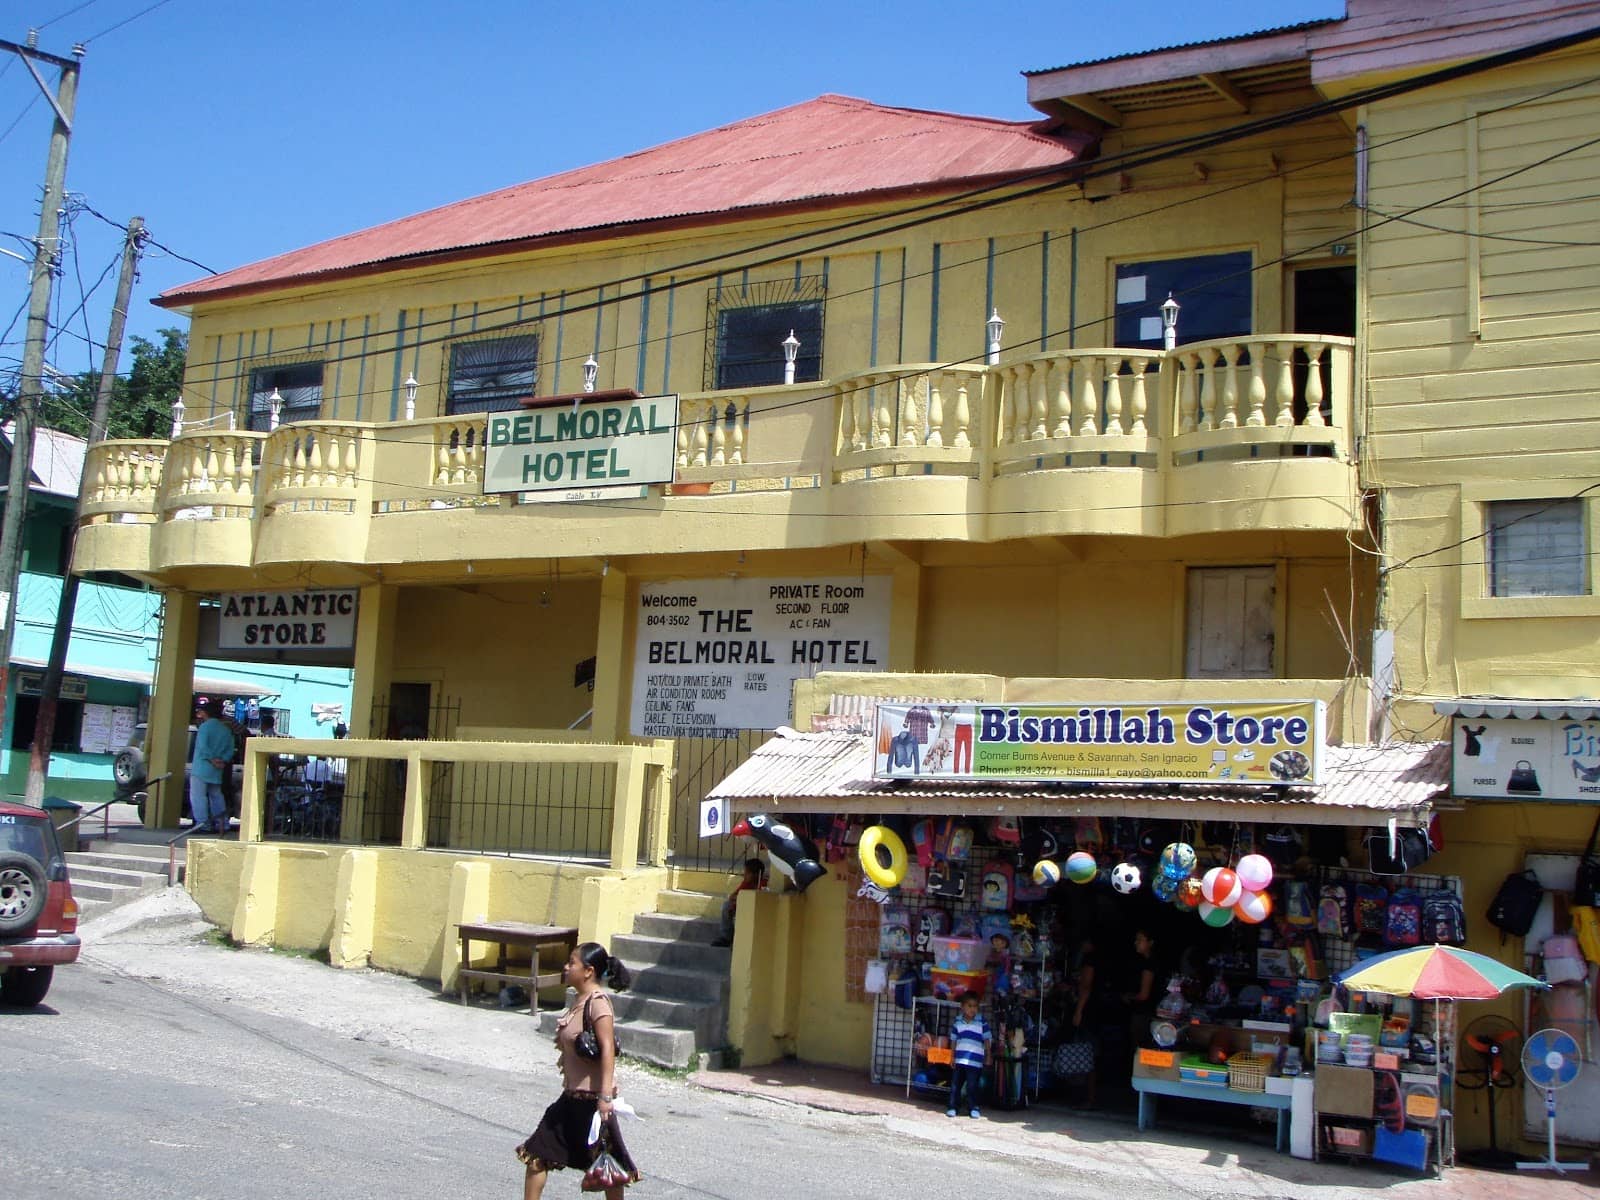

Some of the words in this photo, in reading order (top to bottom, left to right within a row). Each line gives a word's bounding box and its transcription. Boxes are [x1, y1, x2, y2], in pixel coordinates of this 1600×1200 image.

[490, 404, 670, 447] BELMORAL
[522, 447, 630, 484] HOTEL
[769, 584, 820, 599] PRIVATE
[825, 585, 864, 598] Room
[224, 594, 353, 617] ATLANTIC
[642, 594, 697, 608] Welcome
[775, 603, 811, 615] SECOND
[821, 602, 850, 614] FLOOR
[647, 615, 690, 626] 804-3502
[698, 609, 753, 632] THE
[789, 620, 803, 629] AC
[812, 619, 831, 629] FAN
[244, 622, 326, 645] STORE
[648, 640, 775, 664] BELMORAL
[791, 640, 877, 664] HOTEL
[683, 675, 709, 687] PRIVATE
[711, 675, 732, 687] BATH
[747, 673, 765, 681] LOW
[744, 683, 768, 691] RATES
[647, 688, 658, 699] AIR
[660, 688, 698, 700] CONDITION
[701, 688, 727, 700] ROOMS
[645, 700, 673, 712] CEILING
[676, 700, 696, 712] FANS
[644, 712, 667, 724] CABLE
[672, 713, 716, 725] TELEVISION
[980, 708, 1175, 744] Bismillah
[1185, 707, 1308, 745] Store
[979, 750, 1010, 761] Corner
[1012, 751, 1039, 761] Burns
[1041, 752, 1075, 762] Avenue
[1077, 752, 1085, 761] &
[1140, 753, 1159, 762] San
[1162, 752, 1198, 765] Ignacio
[979, 765, 1012, 774] Phone:
[1015, 766, 1057, 775] 824-3271
